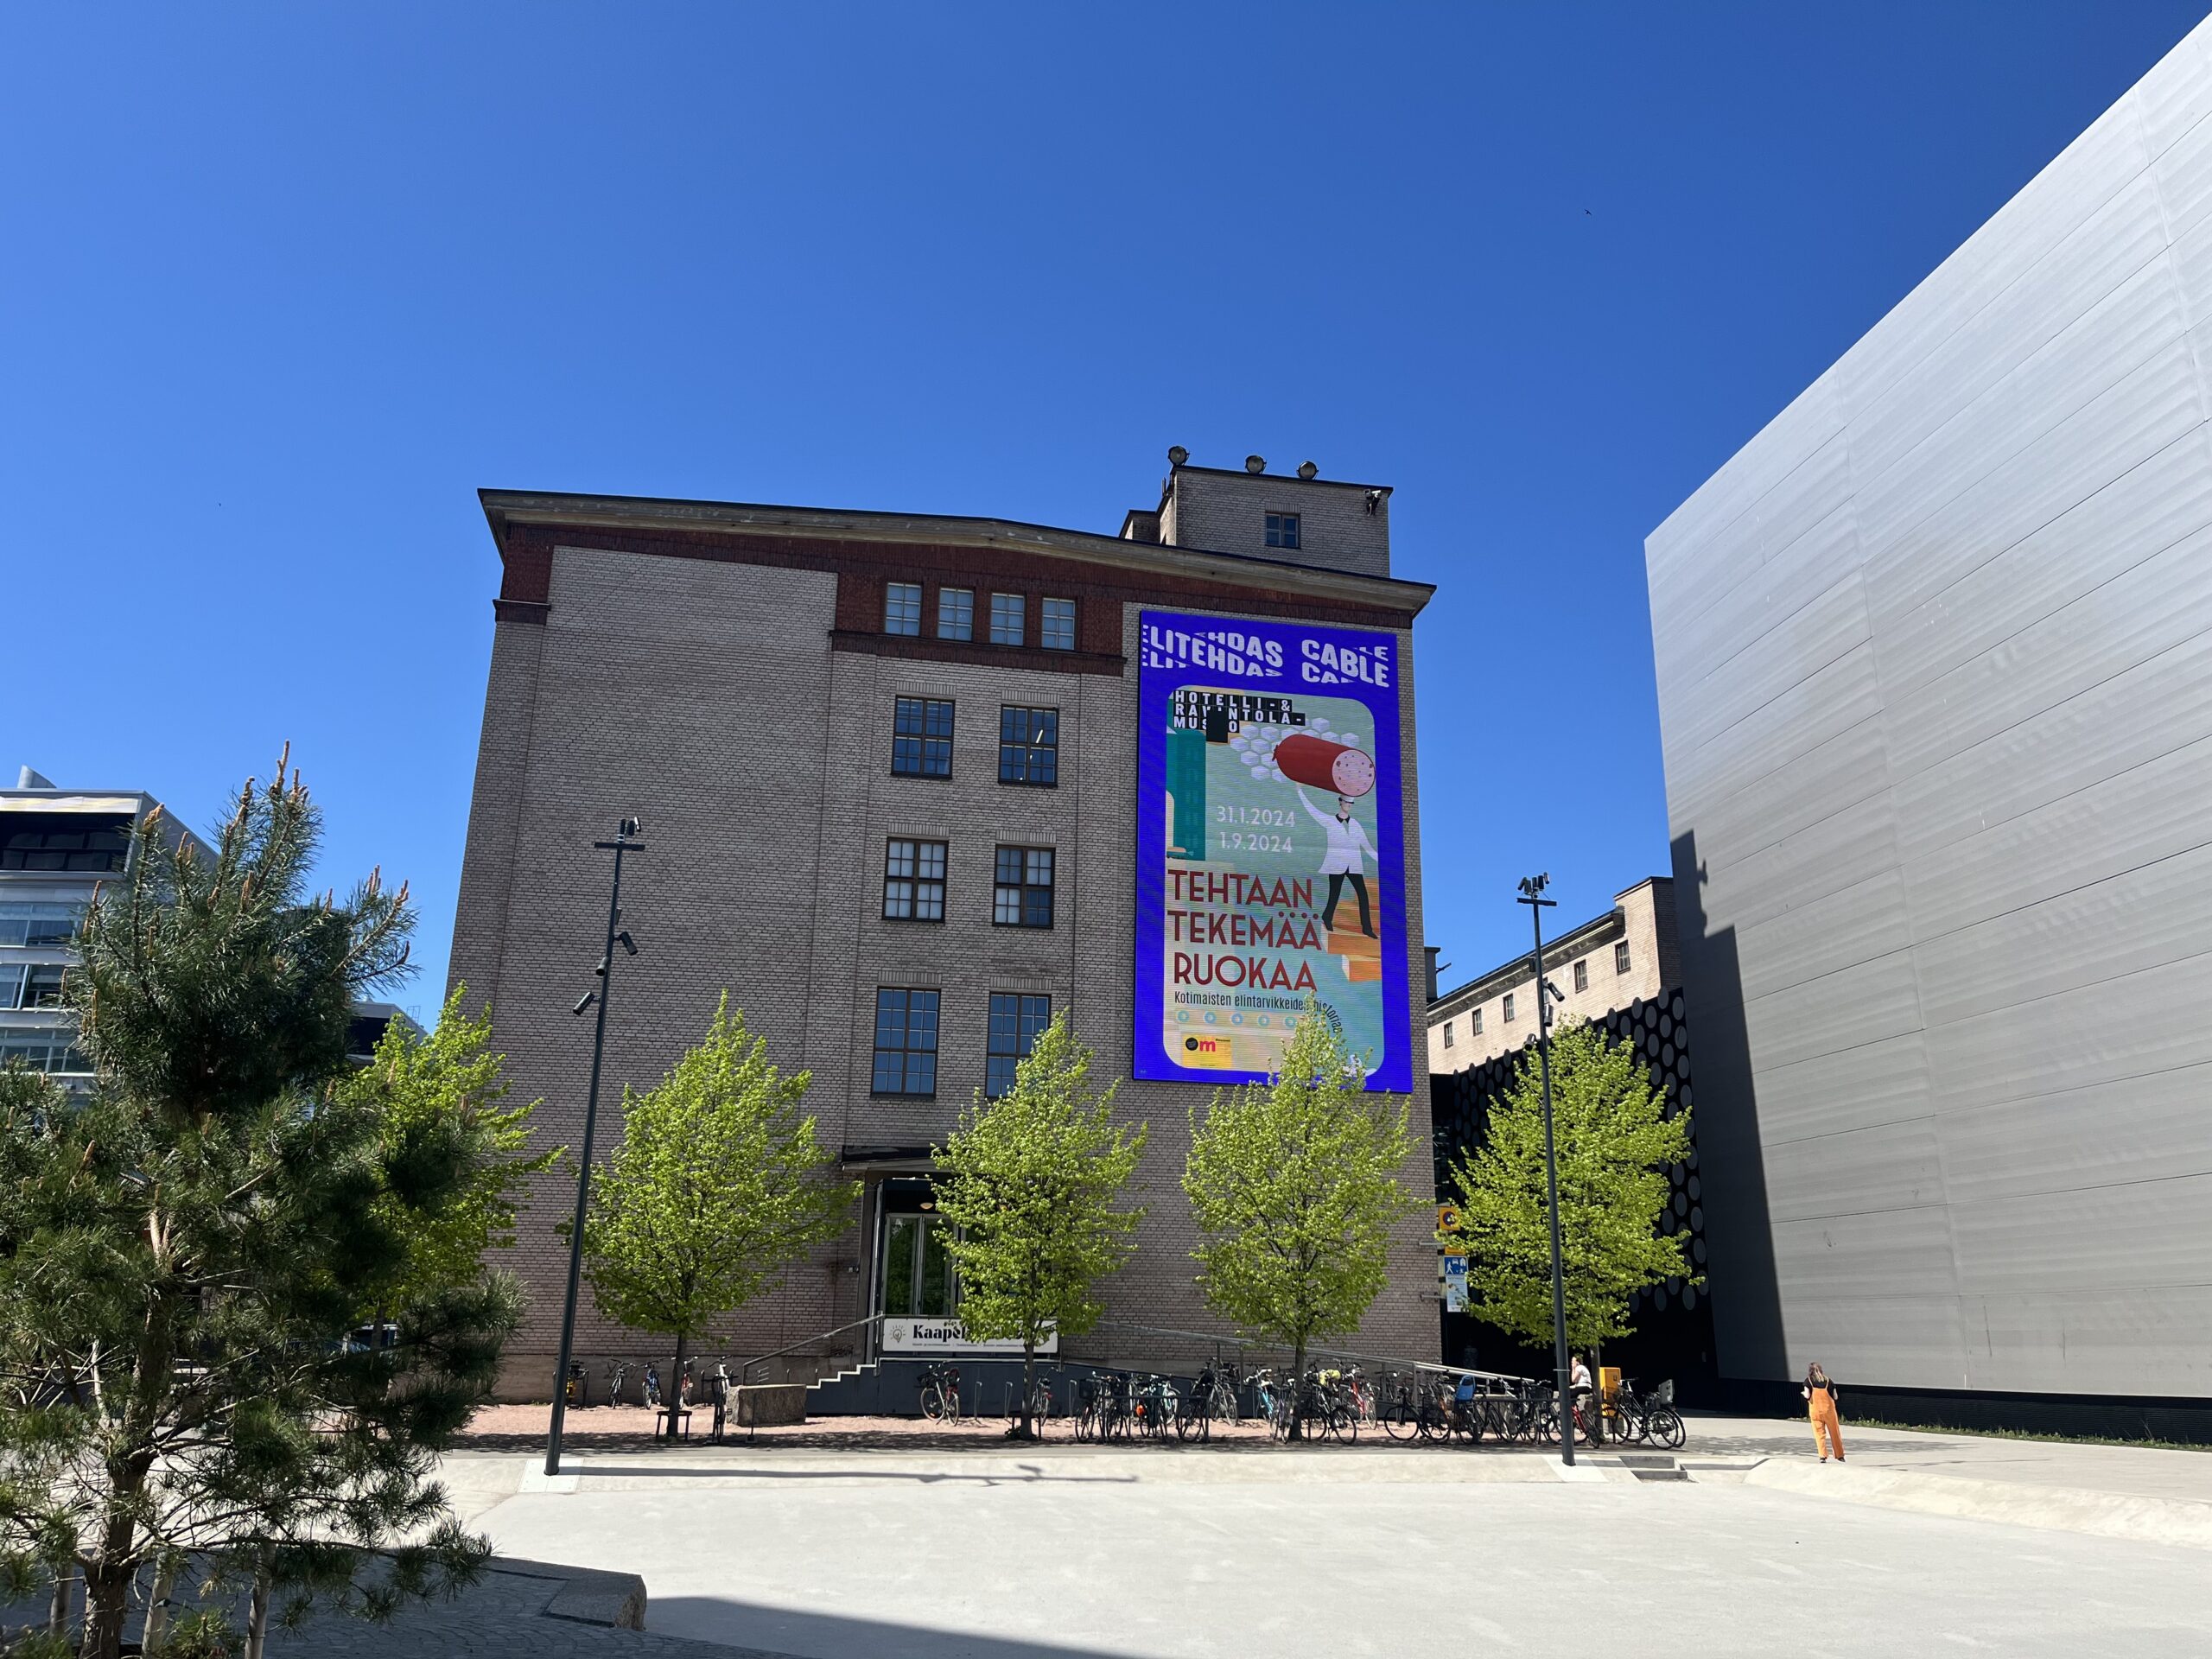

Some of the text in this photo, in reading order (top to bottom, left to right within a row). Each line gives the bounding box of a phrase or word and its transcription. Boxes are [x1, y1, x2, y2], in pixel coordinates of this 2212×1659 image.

[1217, 805, 1296, 827] 31.1.2024
[1219, 832, 1294, 853] 1.9.2024
[1167, 869, 1312, 908] TEHTAAN
[1167, 911, 1322, 950] TEKEMÄÄ
[1174, 952, 1318, 991] RUOKAA
[1174, 991, 1231, 1007] Kotimaisten
